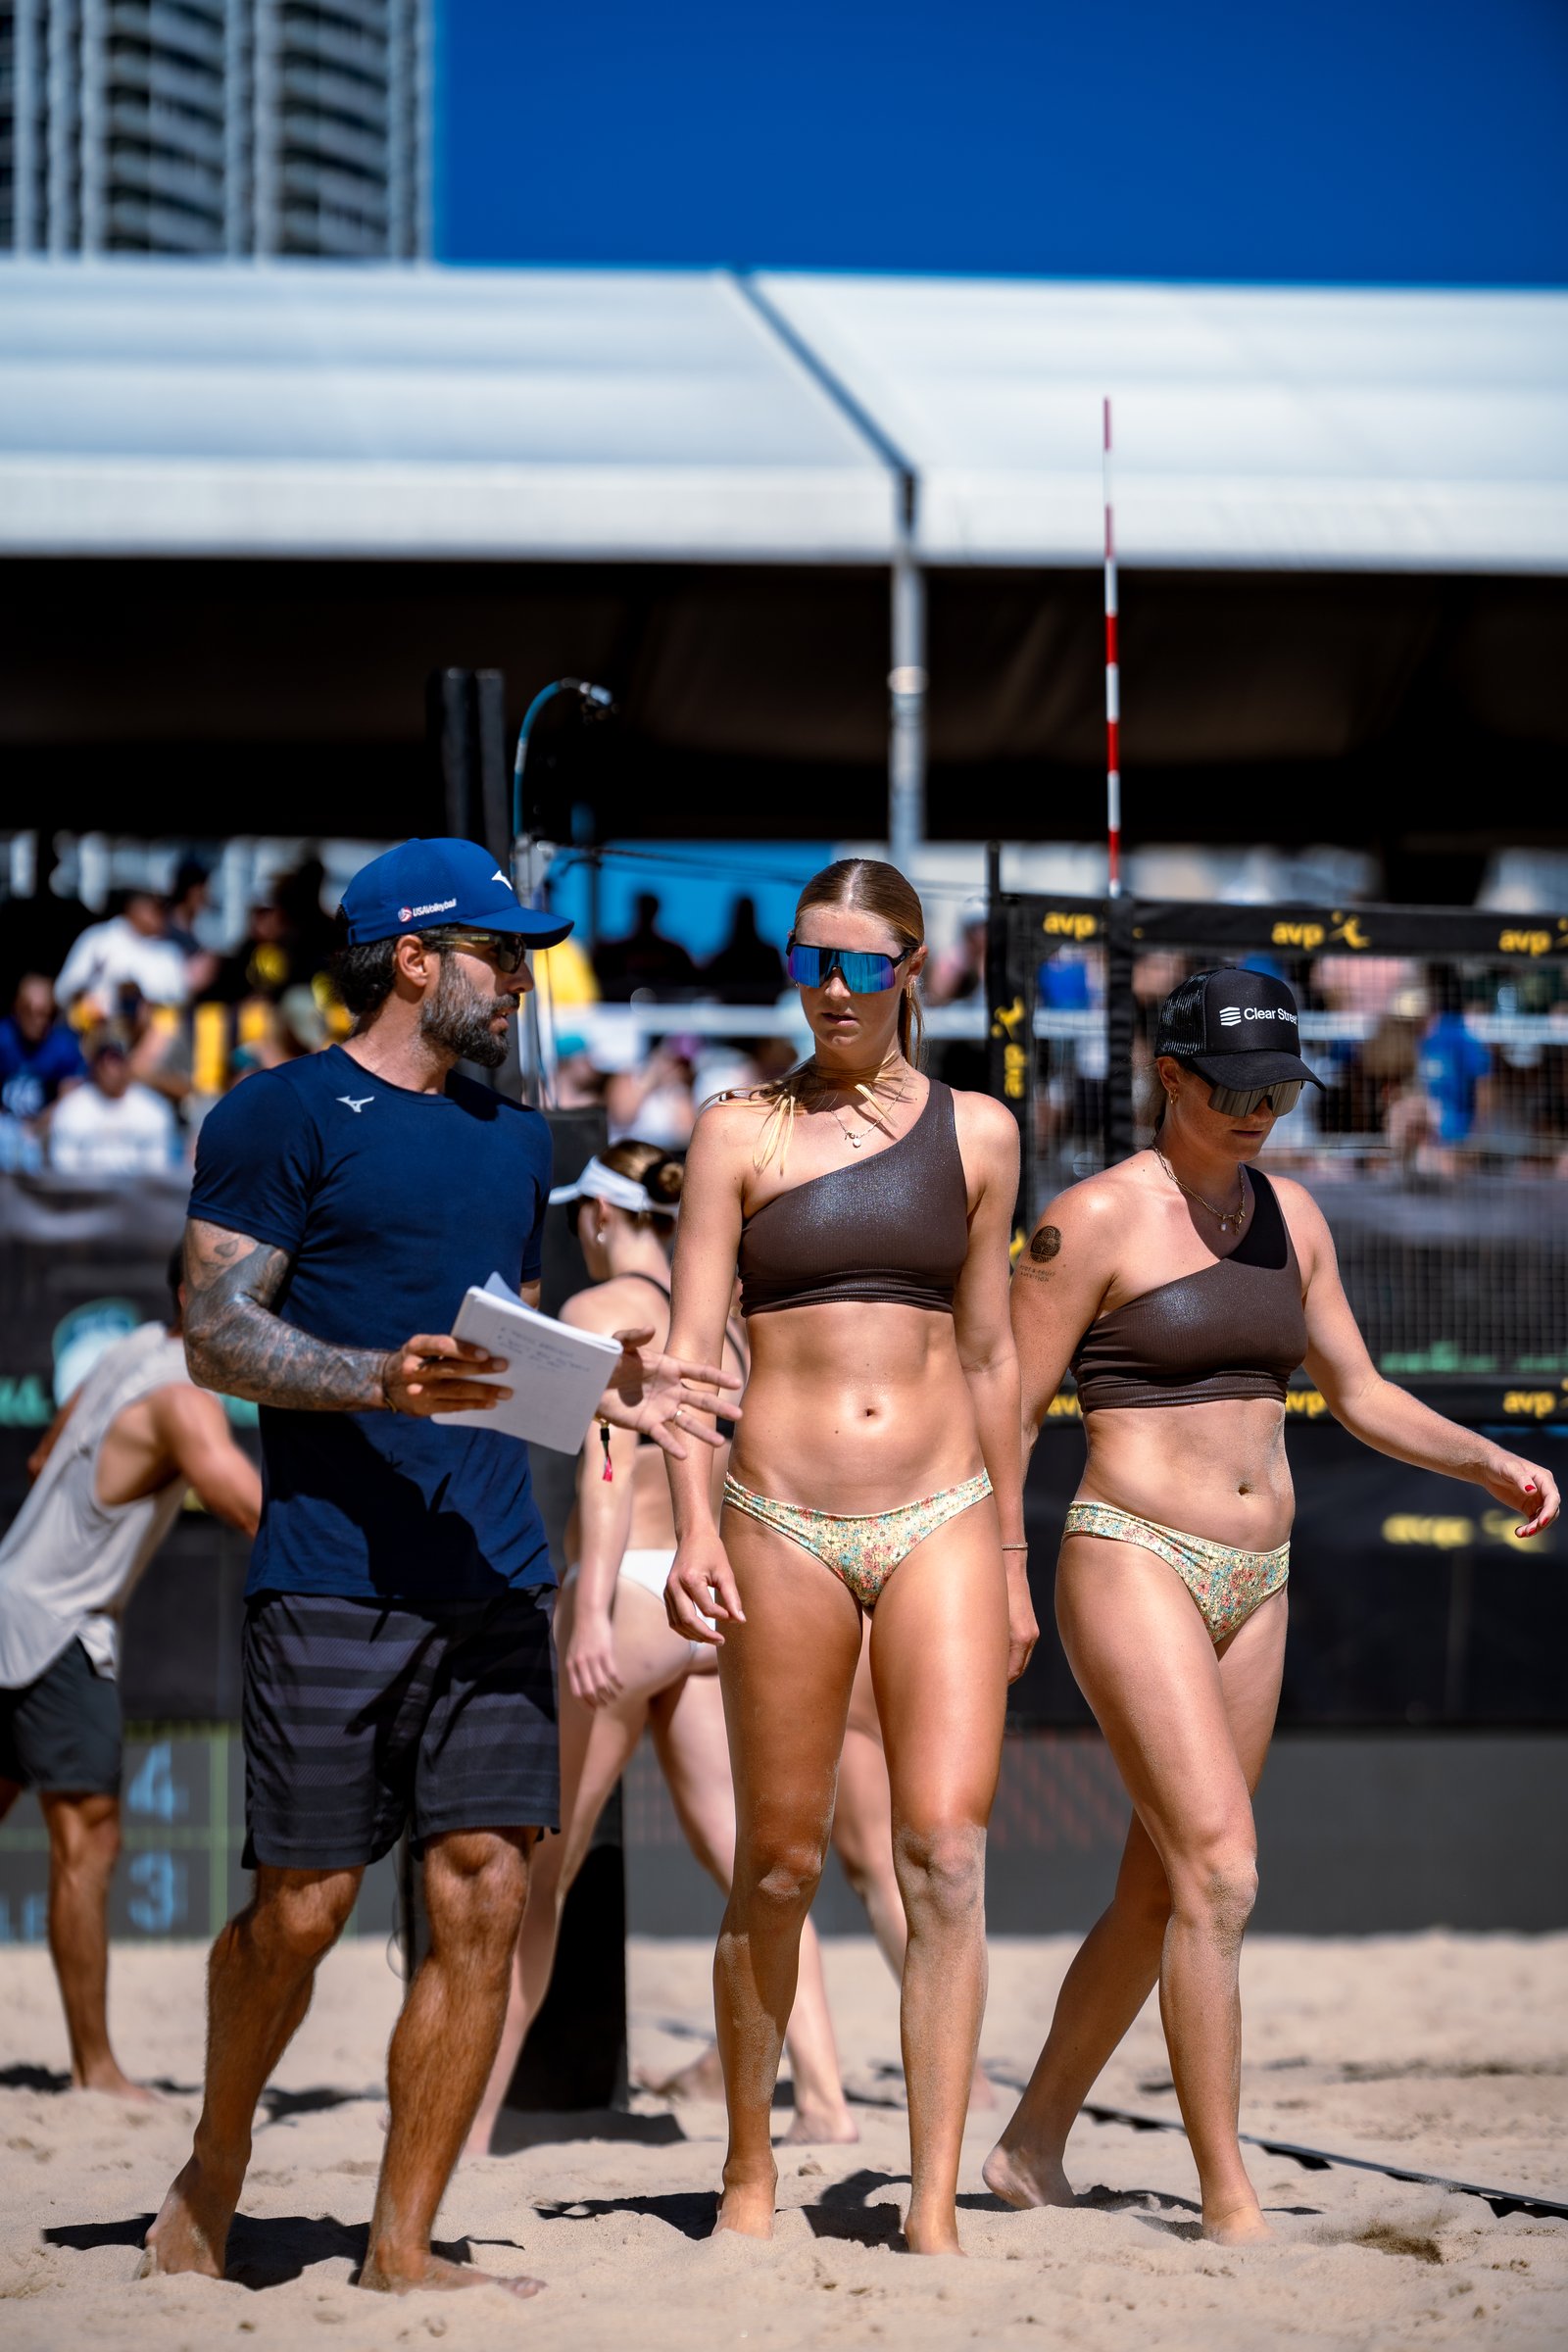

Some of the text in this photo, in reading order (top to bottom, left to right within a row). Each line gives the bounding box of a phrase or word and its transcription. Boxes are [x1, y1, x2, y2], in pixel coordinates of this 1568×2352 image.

[1043, 911, 1097, 941] avp
[1271, 921, 1324, 951] avp
[1498, 929, 1552, 956] avp
[1244, 1007, 1276, 1020] Clear
[1503, 1391, 1556, 1419] avp
[127, 1740, 189, 1823] 4
[127, 1852, 188, 1931] 3
